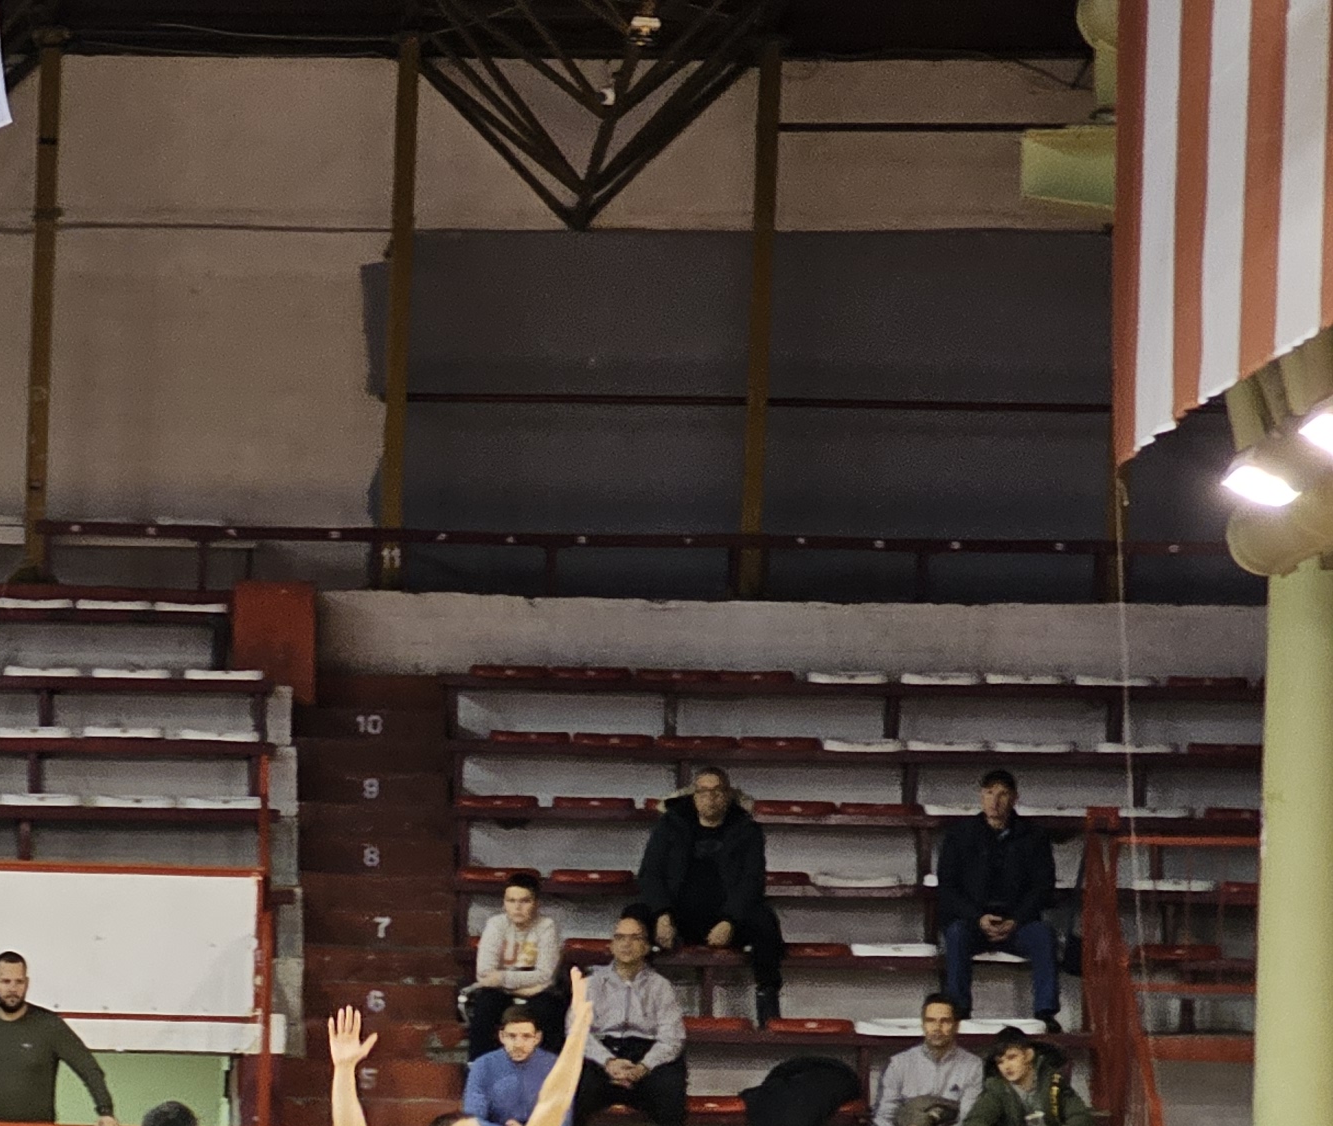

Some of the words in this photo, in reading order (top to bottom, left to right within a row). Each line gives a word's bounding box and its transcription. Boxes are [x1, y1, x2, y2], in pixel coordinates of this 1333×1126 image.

[355, 714, 384, 736] 10
[363, 846, 380, 868] 8
[374, 916, 392, 939] 7
[367, 989, 386, 1014] 6
[359, 1068, 377, 1091] 5
